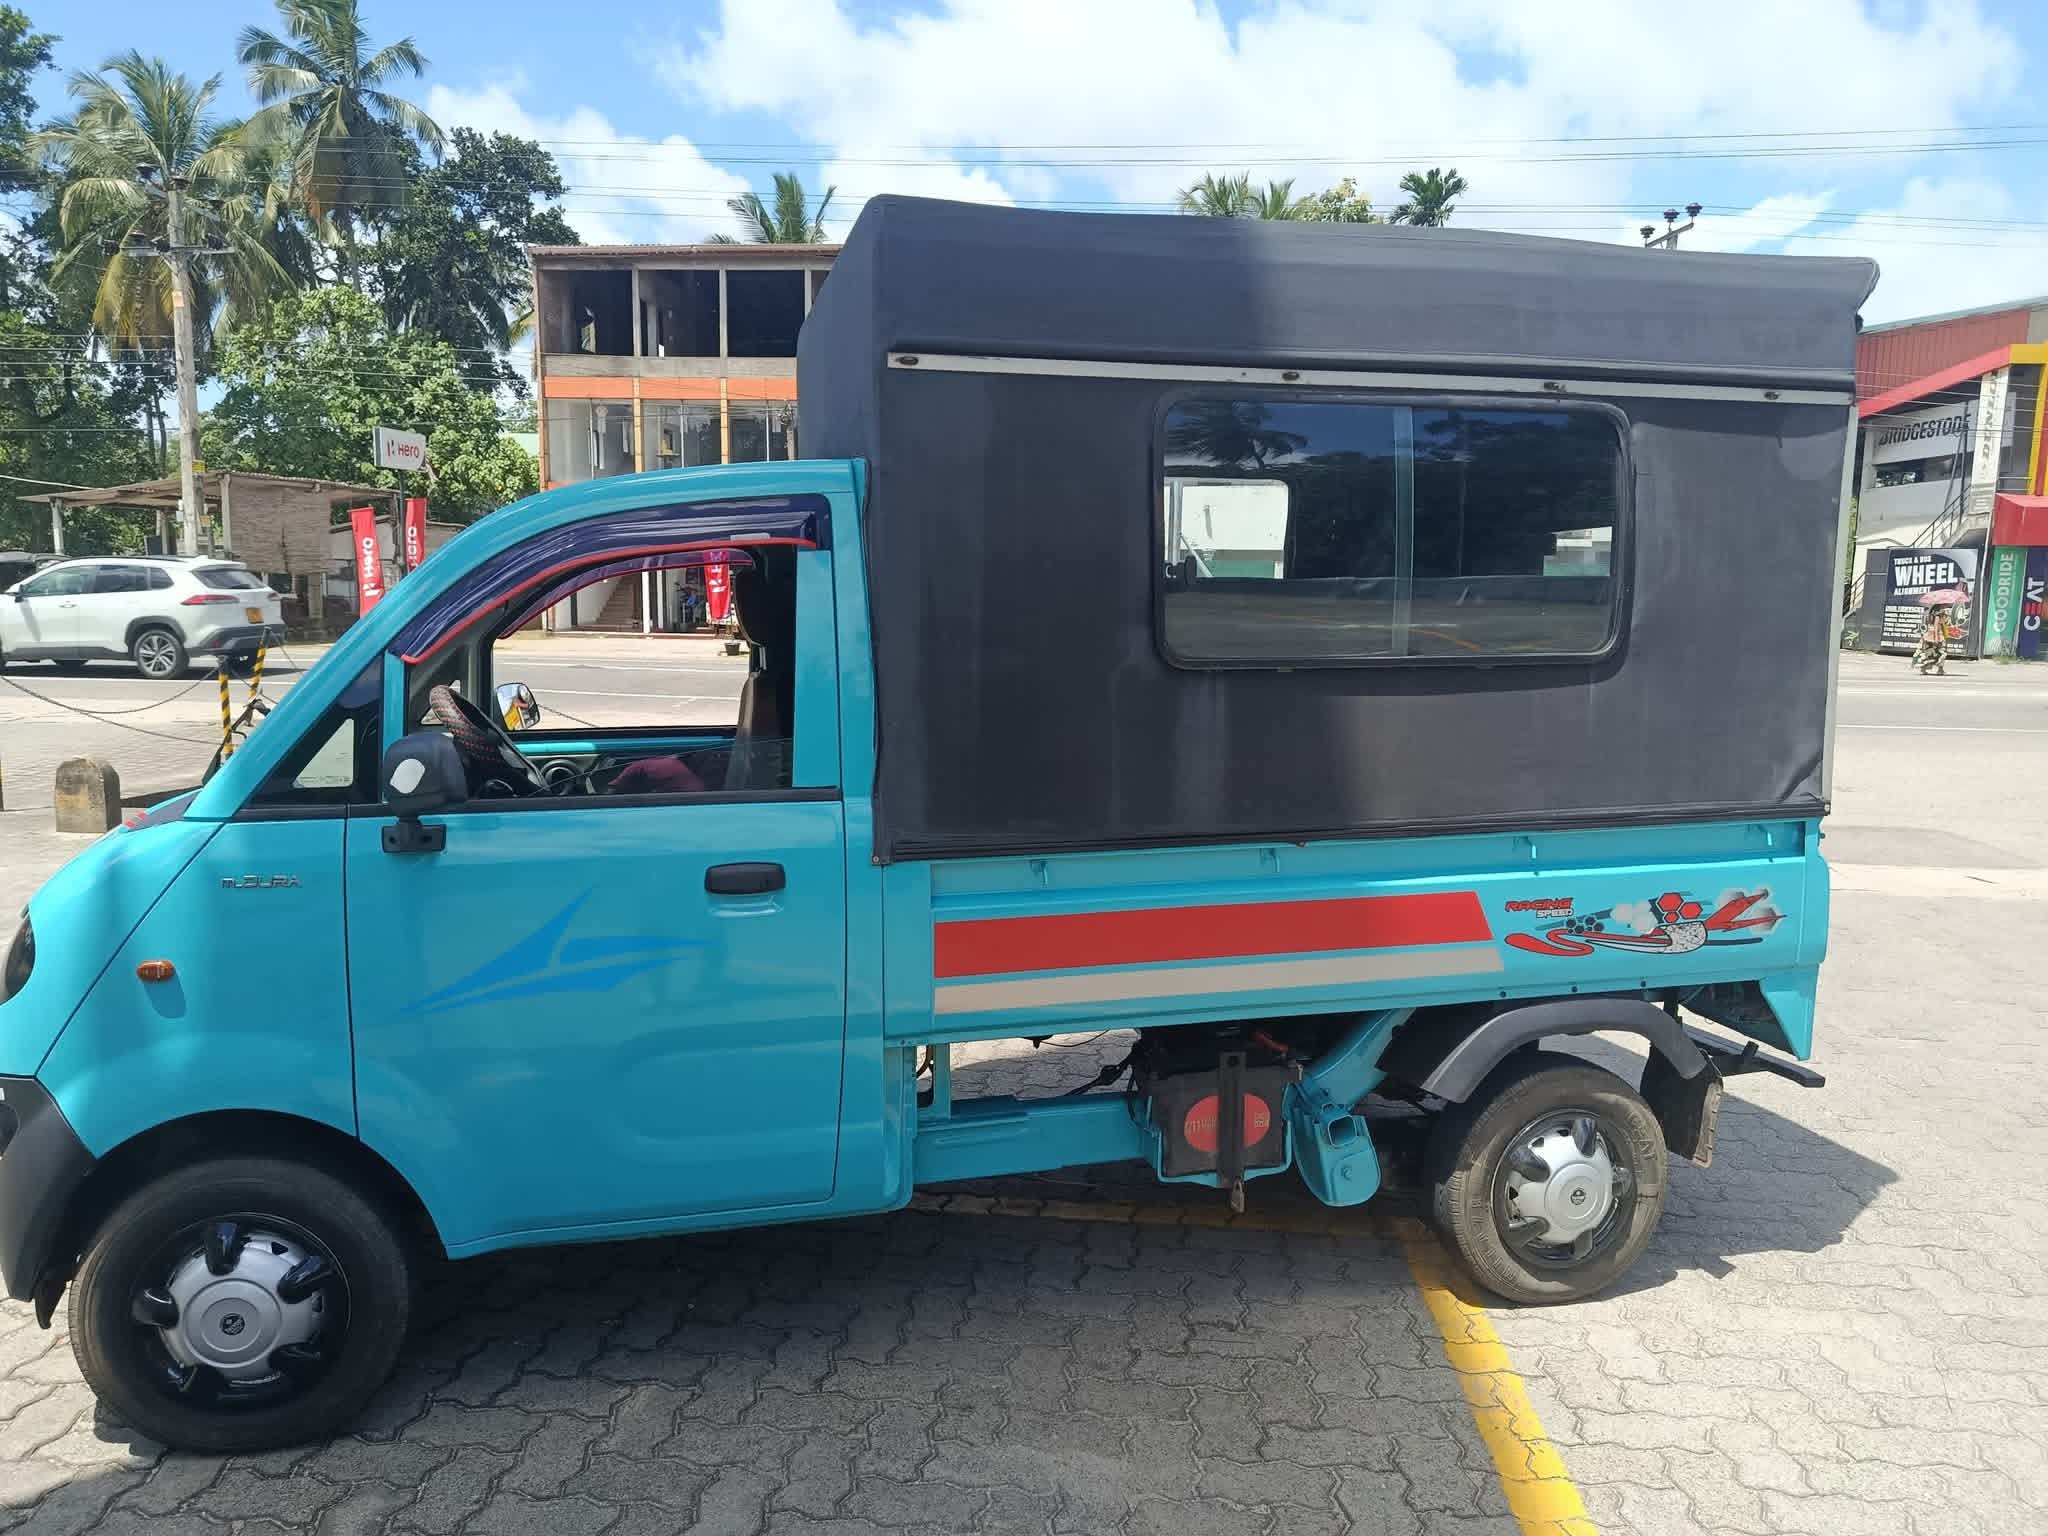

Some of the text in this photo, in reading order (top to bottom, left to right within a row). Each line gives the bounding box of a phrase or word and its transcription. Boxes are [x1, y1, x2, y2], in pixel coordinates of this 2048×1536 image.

[1879, 414, 1971, 446] BRIDGESTONE
[397, 443, 419, 458] Hero
[362, 537, 374, 578] Hero
[1894, 562, 1958, 587] WHEEL
[1993, 552, 2014, 633] GOODRIDE
[2023, 577, 2045, 631] CEAT
[1505, 897, 1574, 912] RACING
[1536, 908, 1574, 918] SPEED
